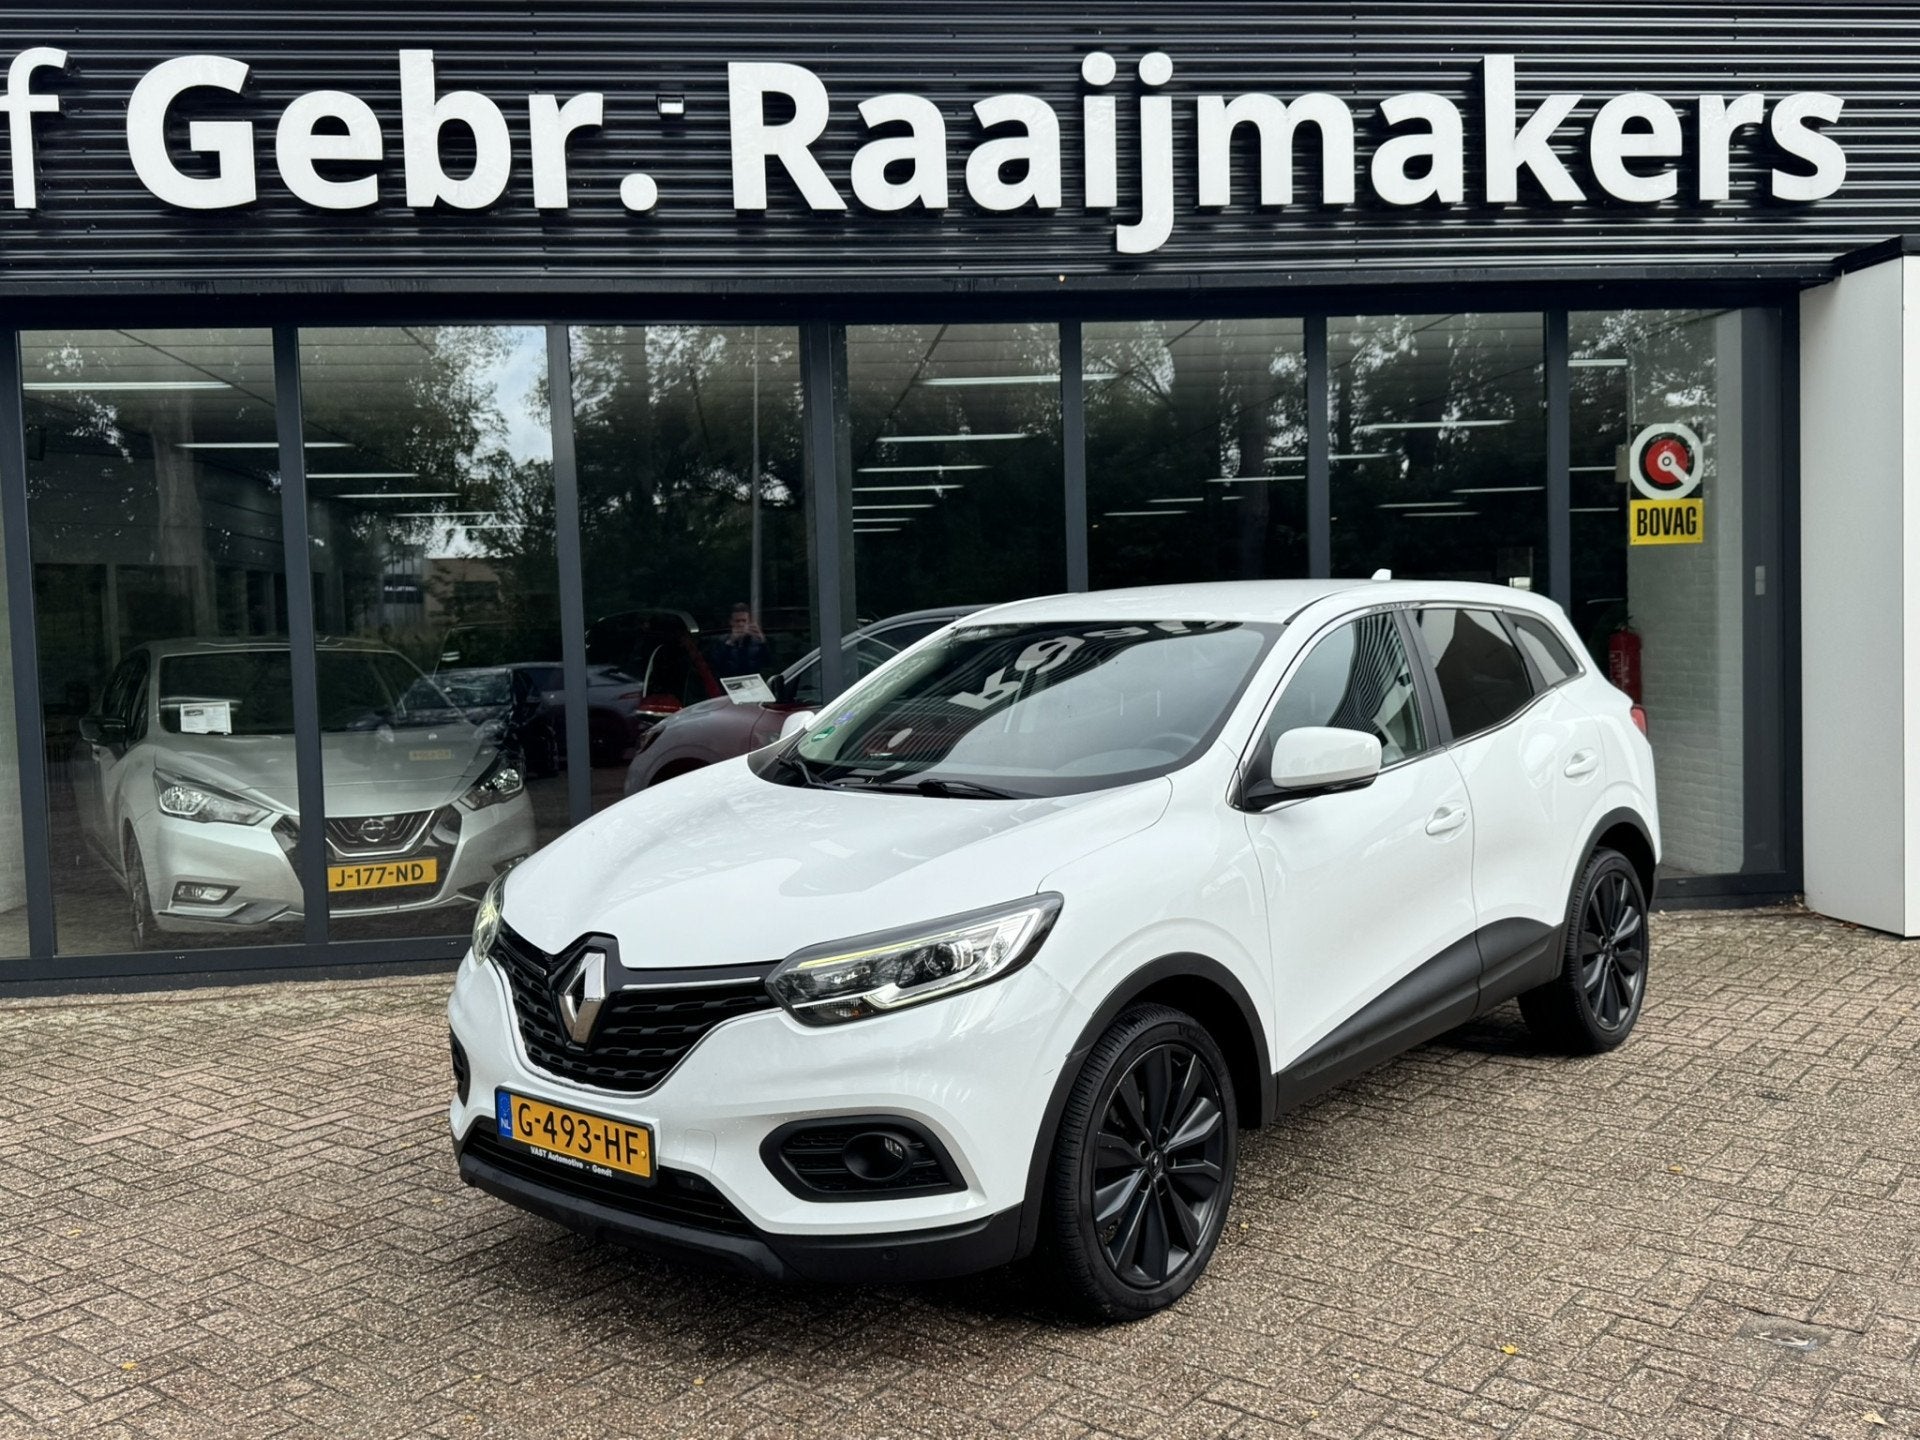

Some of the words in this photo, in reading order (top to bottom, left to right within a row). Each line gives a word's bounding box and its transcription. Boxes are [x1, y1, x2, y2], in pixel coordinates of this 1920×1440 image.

[126, 49, 658, 211] Gebr.
[732, 52, 1847, 254] Raaijmakers
[1636, 506, 1697, 537] BOVAG
[335, 863, 424, 887] J-177-ND
[500, 1117, 511, 1130] NL
[518, 1102, 639, 1166] G-493-HF
[530, 1146, 547, 1158] VAST
[548, 1151, 584, 1169] Automotive
